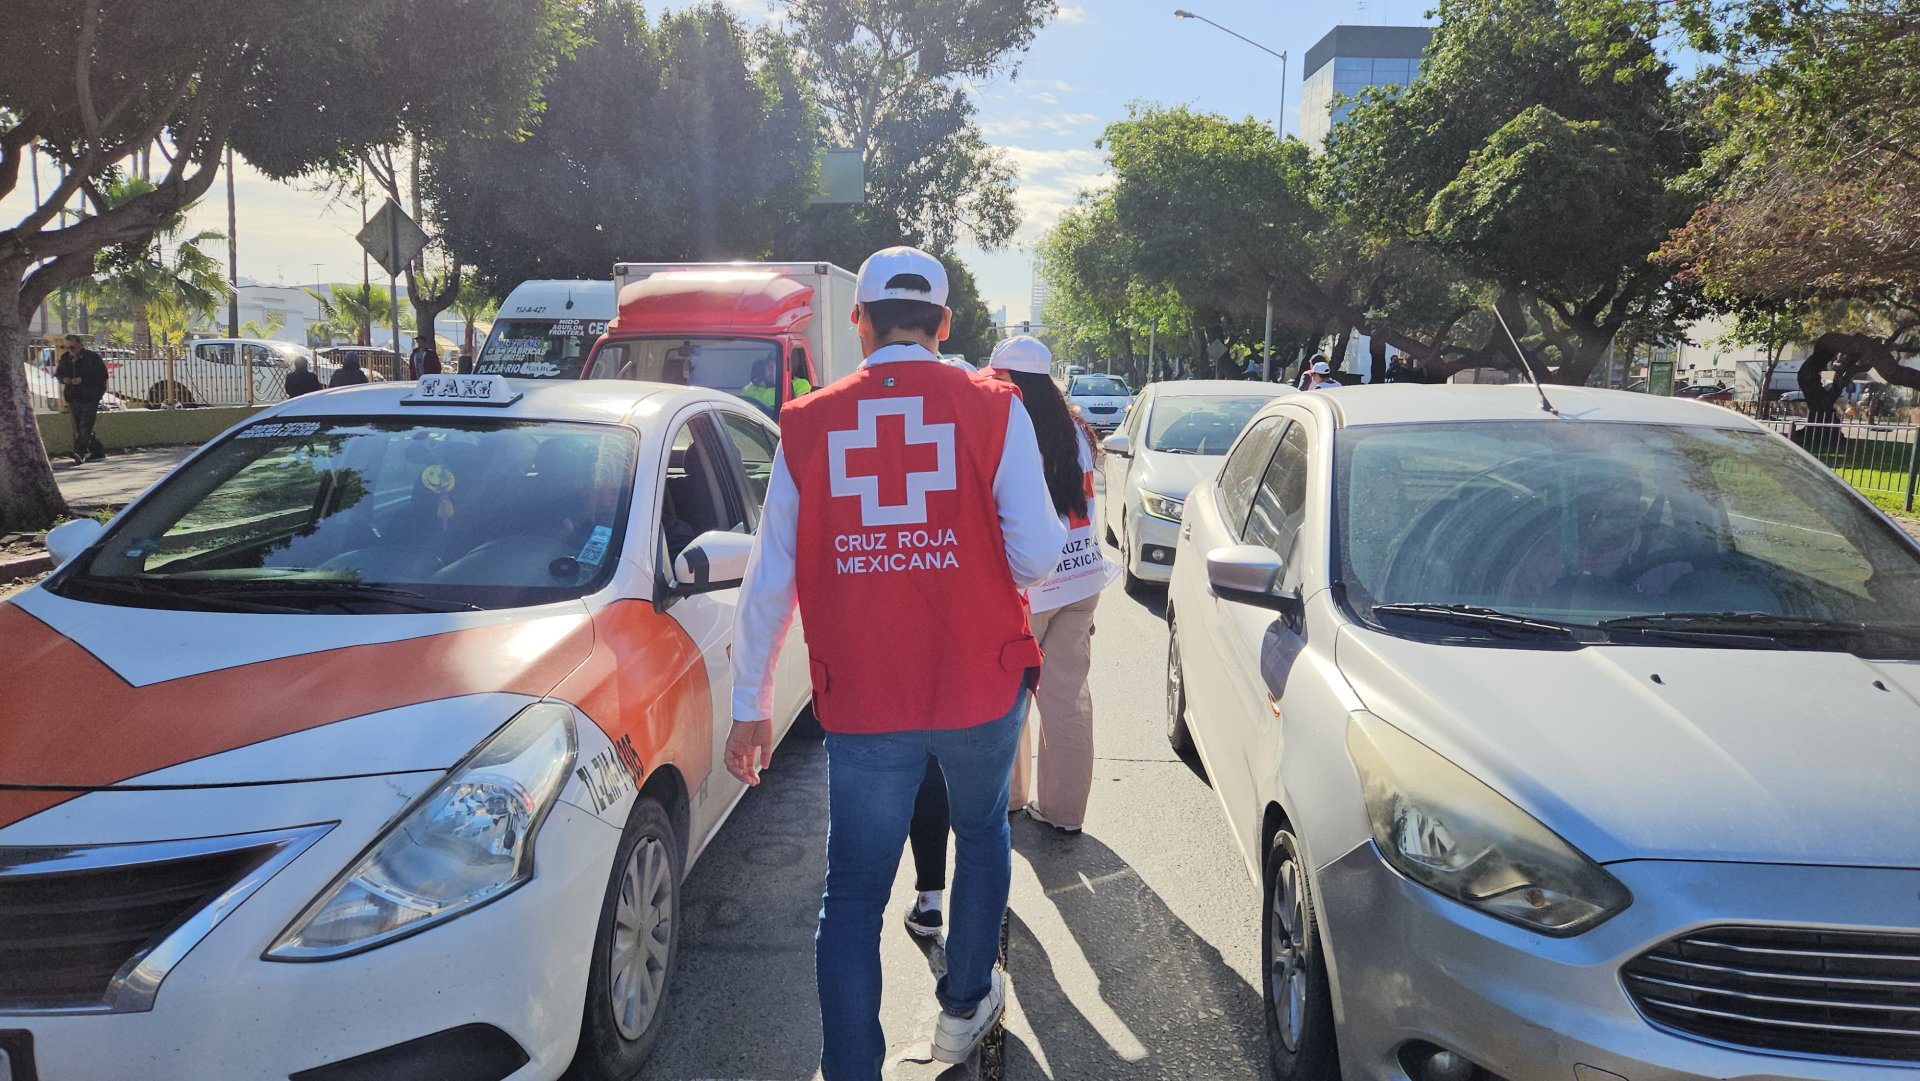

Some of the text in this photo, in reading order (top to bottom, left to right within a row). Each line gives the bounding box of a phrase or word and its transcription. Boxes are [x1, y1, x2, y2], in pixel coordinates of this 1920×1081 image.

[421, 378, 493, 399] TAXI
[834, 528, 959, 553] CRUZ ROJA
[836, 550, 960, 575] MEXICANA
